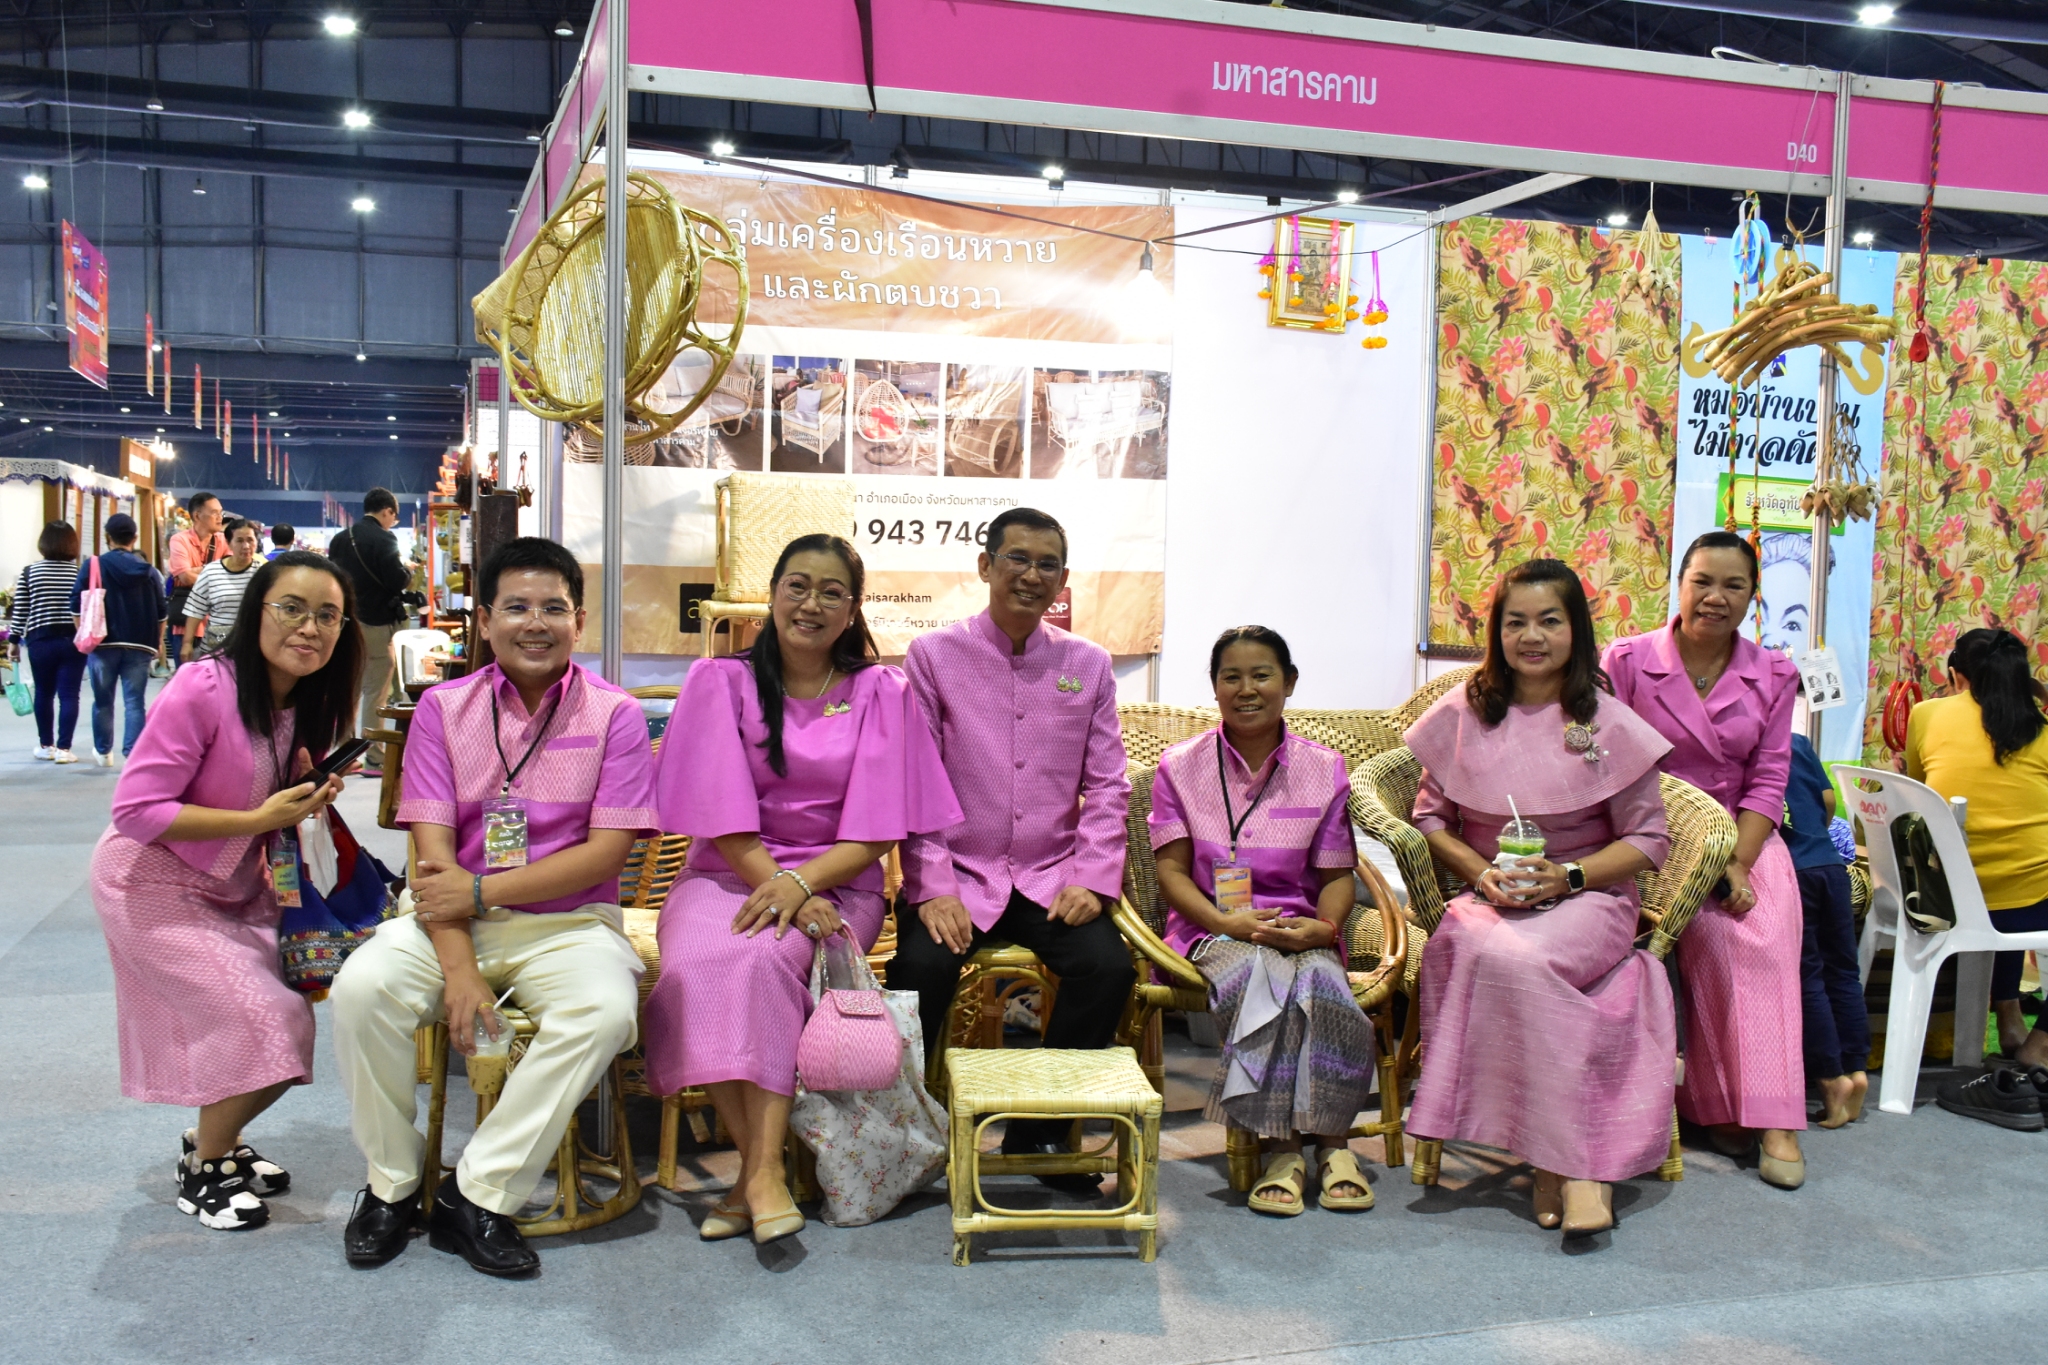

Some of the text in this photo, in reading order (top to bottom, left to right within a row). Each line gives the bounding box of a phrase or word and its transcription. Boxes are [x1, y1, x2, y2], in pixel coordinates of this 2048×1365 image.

[1212, 61, 1377, 105] มหาสารคาม
[1787, 142, 1818, 163] D40
[764, 269, 1002, 310] และผักตบชวา
[866, 491, 923, 505] อำเภอเมือง
[926, 494, 1019, 507] จังหวัดมหาสารคาม
[868, 519, 925, 545] 943
